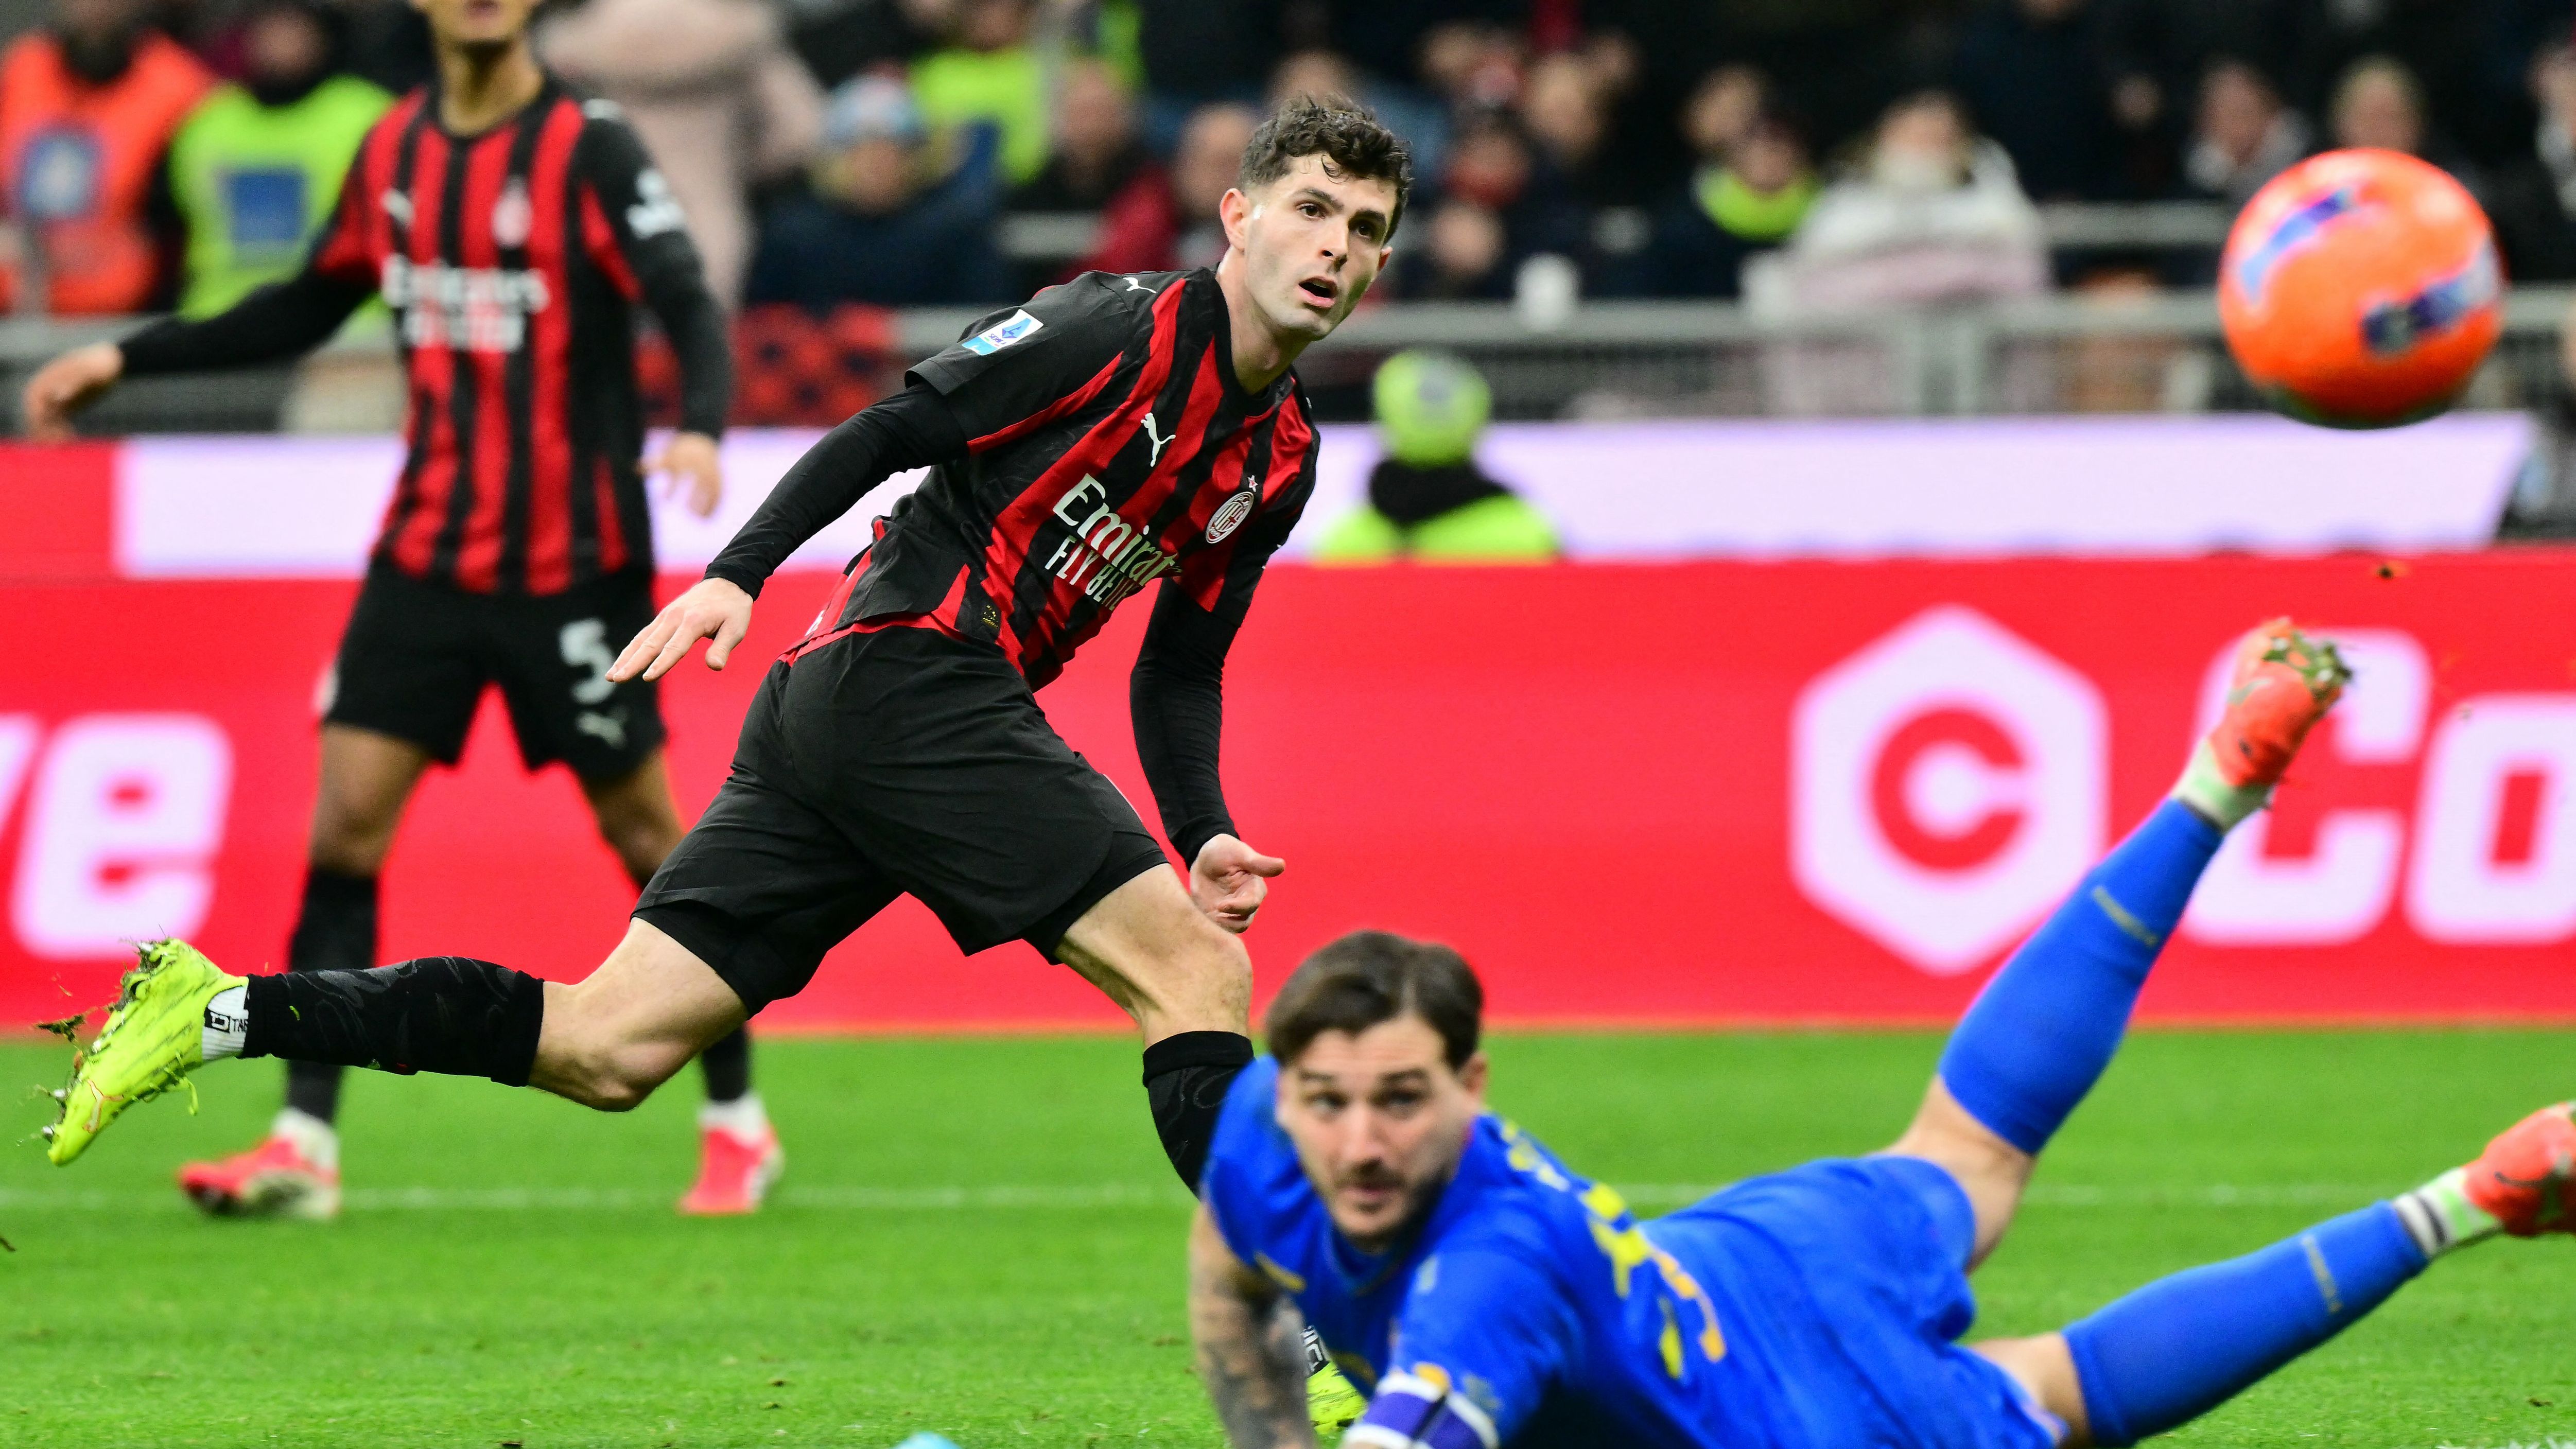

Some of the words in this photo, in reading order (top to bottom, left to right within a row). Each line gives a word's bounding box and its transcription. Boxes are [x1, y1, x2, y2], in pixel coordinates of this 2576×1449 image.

[1045, 535, 1100, 585] FLY
[1053, 473, 1182, 587] Emirat
[560, 619, 617, 704] 5
[0, 712, 234, 961] e
